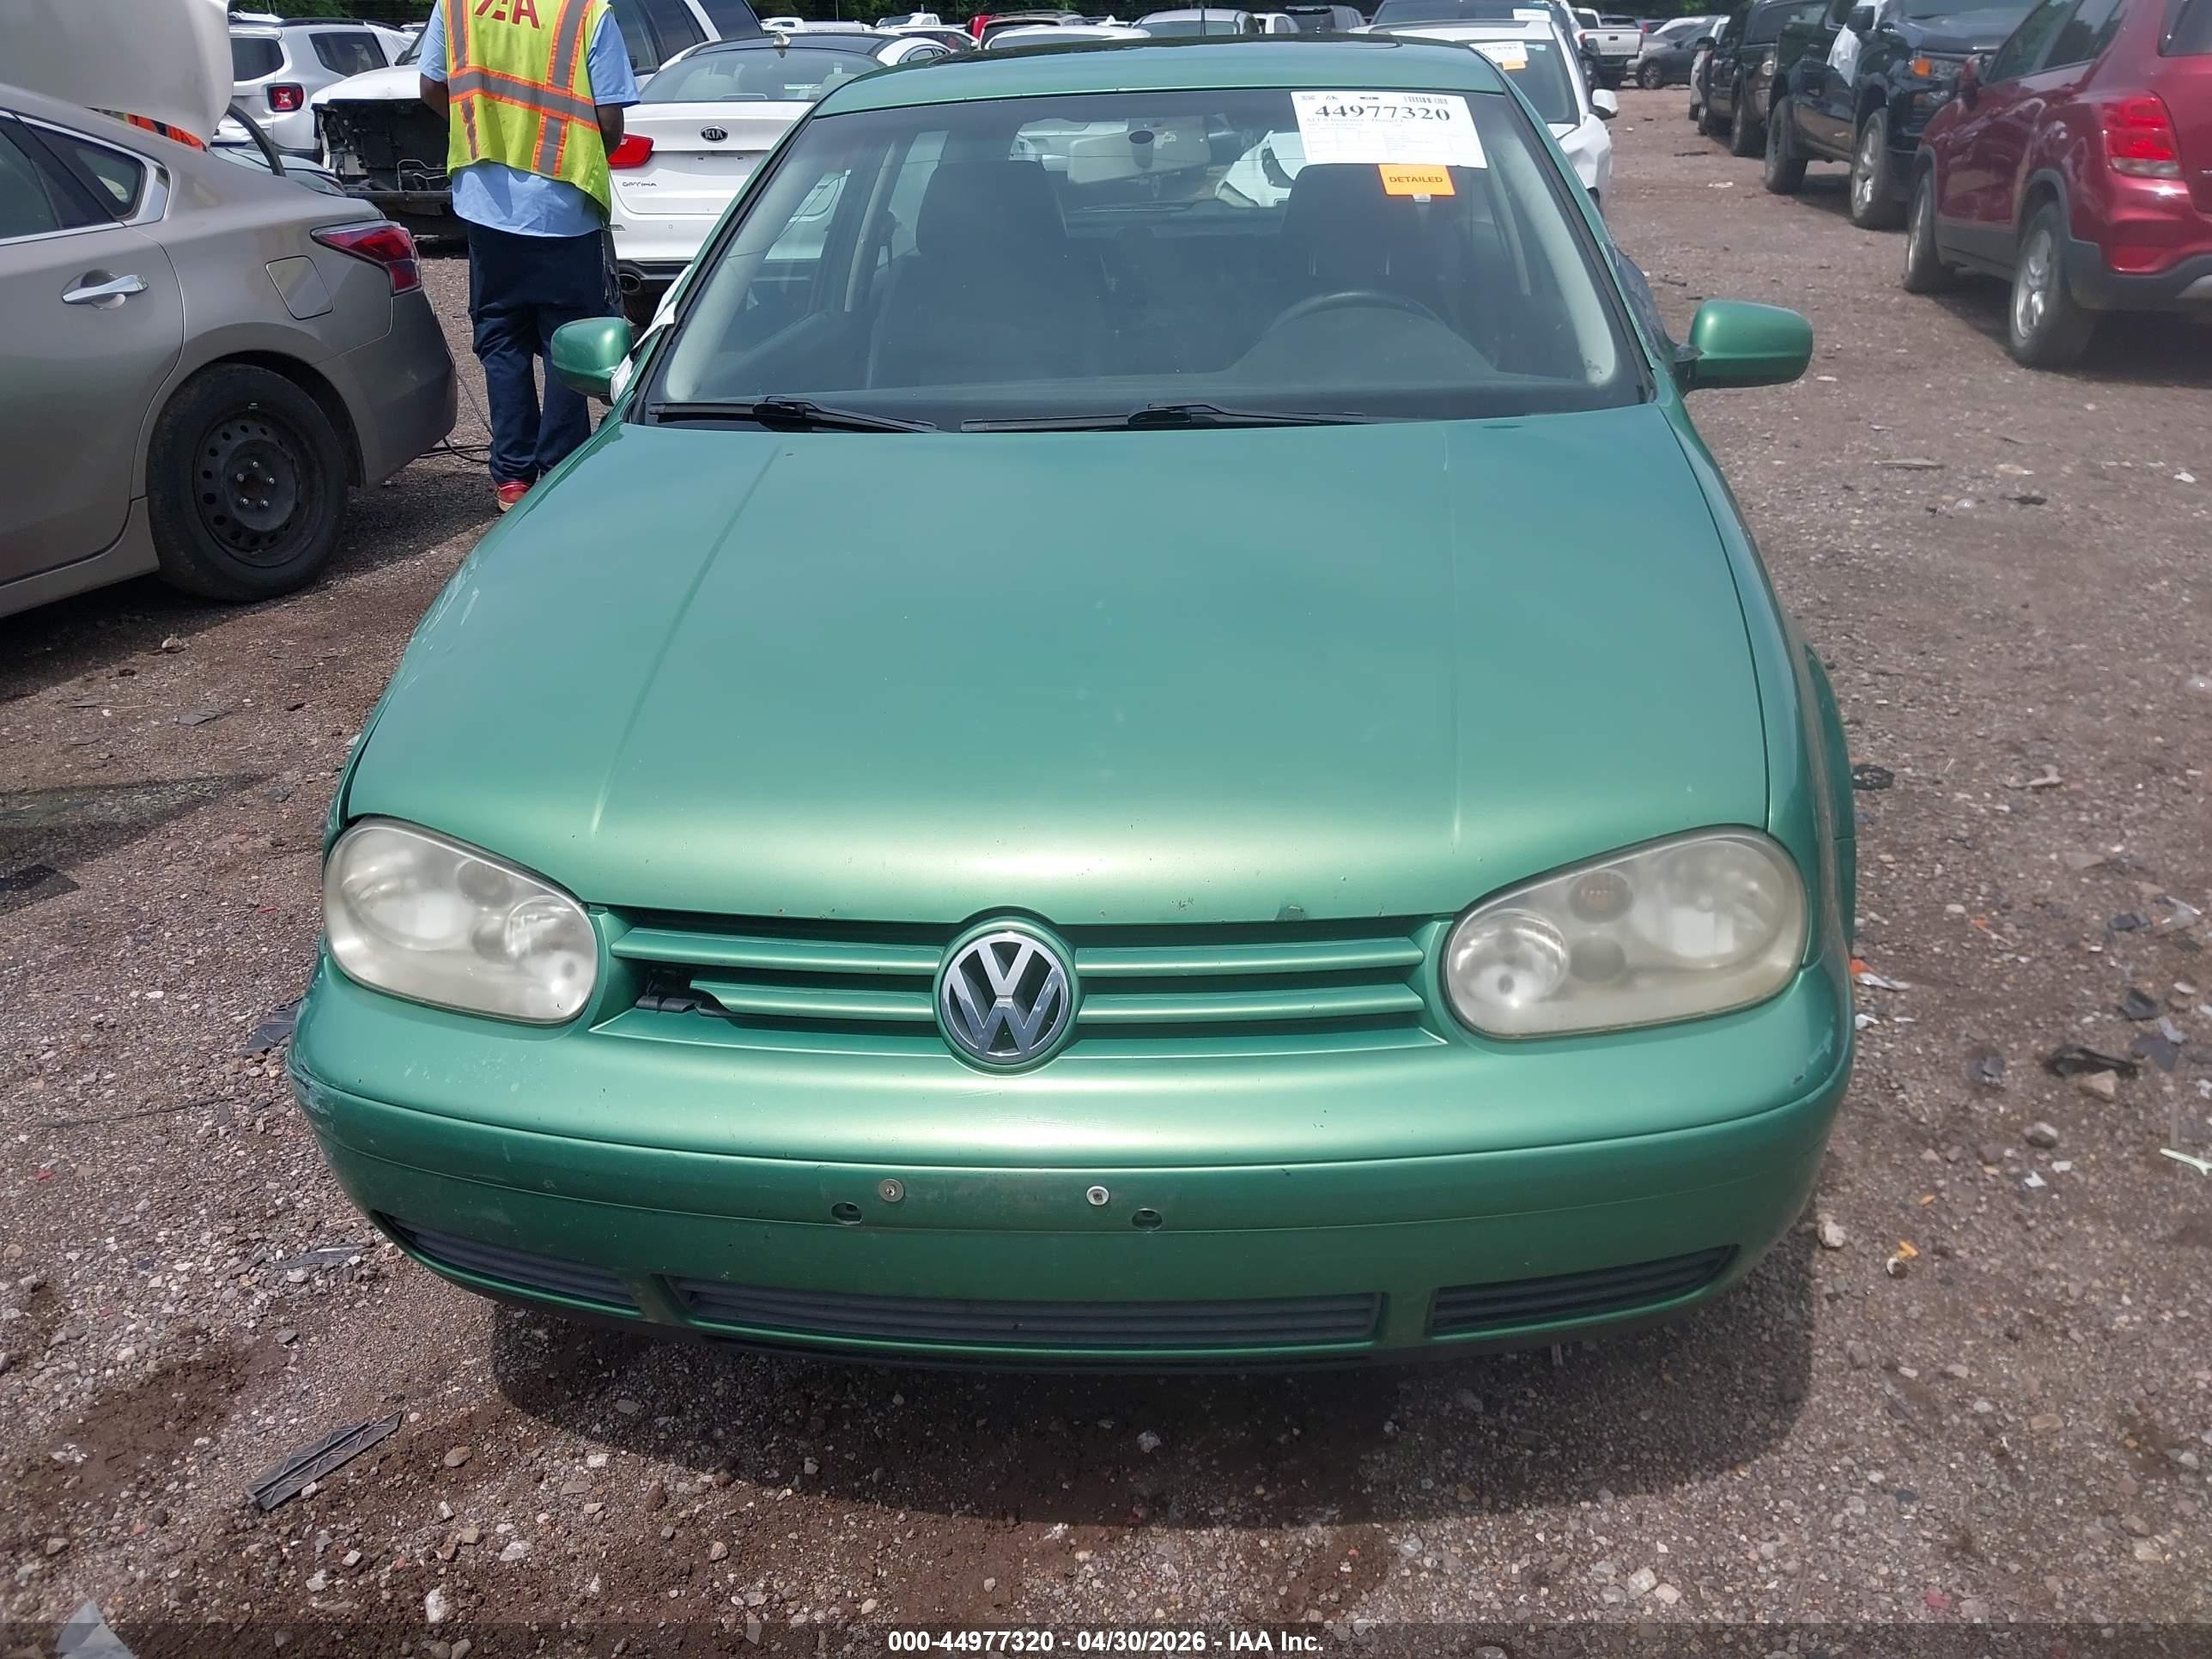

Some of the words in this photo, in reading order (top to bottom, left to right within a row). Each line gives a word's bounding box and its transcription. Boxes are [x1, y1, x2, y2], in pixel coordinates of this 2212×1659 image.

[1315, 105, 1450, 121] 44977320
[704, 130, 725, 139] KIA
[942, 931, 1069, 1065] VW
